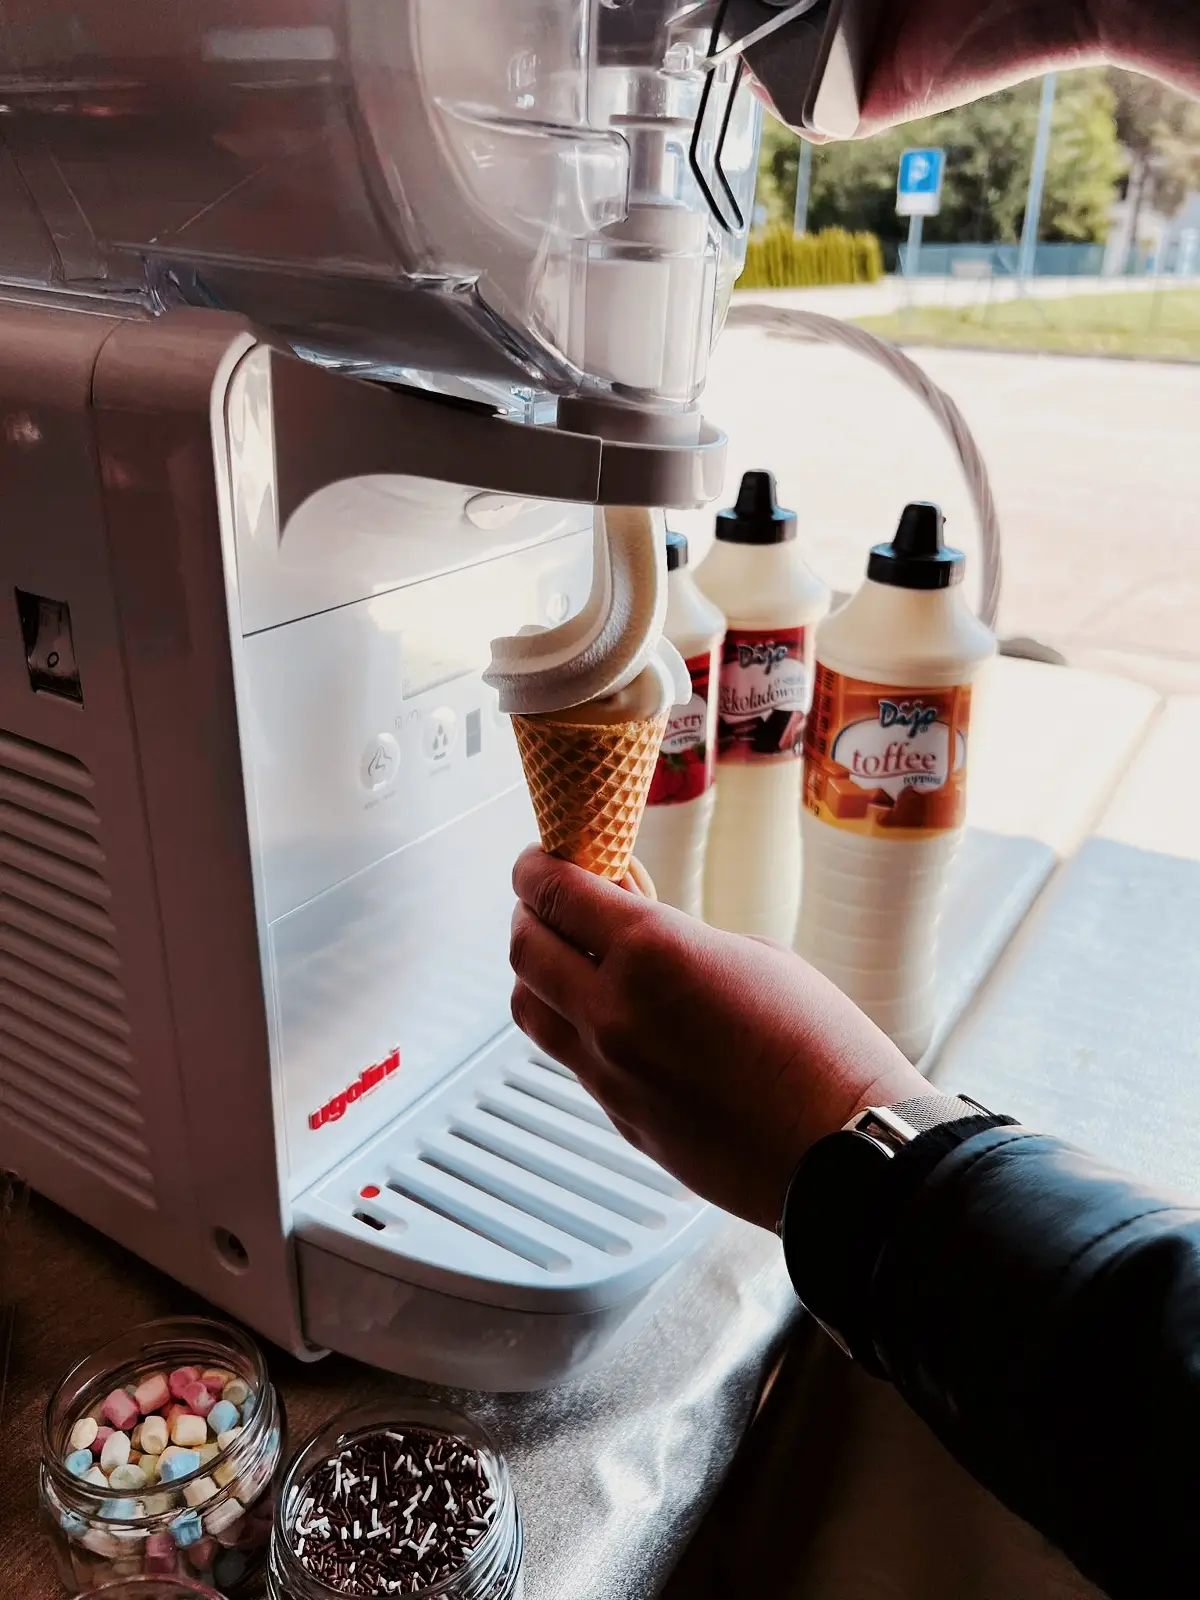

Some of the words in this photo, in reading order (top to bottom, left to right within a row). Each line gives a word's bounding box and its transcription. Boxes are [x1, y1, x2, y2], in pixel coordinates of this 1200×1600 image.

[907, 155, 930, 192] P
[737, 641, 788, 675] Dijo
[878, 699, 938, 738] Dijo
[851, 741, 937, 775] toffee
[309, 1046, 401, 1131] ugolini
